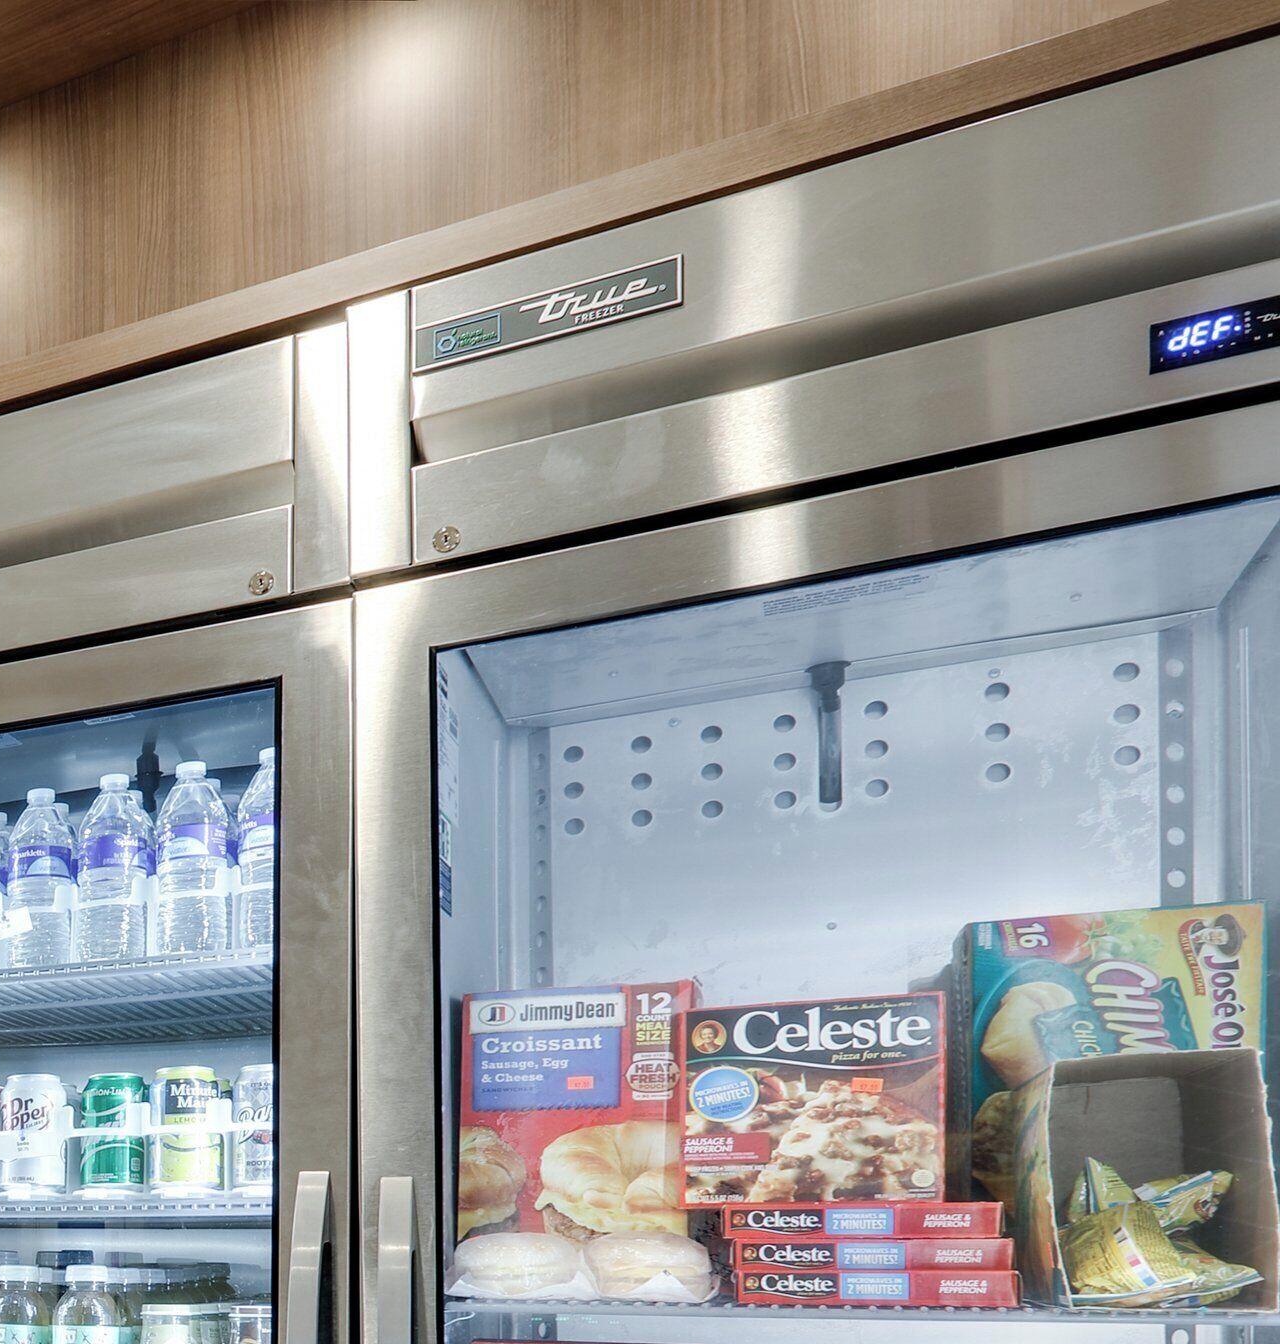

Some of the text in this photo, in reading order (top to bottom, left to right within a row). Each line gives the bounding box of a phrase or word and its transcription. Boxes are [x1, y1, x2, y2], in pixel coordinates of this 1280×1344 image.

[575, 304, 624, 324] FREEZER
[636, 992, 672, 1014] 12
[636, 1021, 671, 1031] MEAL
[733, 1006, 932, 1055] Celeste
[636, 1030, 671, 1042] SIZE
[481, 1033, 603, 1054] Croissant
[481, 1058, 570, 1070] Sausage, Egg
[635, 1063, 672, 1073] HEAT
[481, 1072, 544, 1083] & Cheese
[630, 1072, 676, 1084] FRESH
[170, 1084, 218, 1097] Minute
[12, 1098, 33, 1116] Dr
[684, 1145, 733, 1153] PEPPERONI
[747, 1211, 819, 1228] Celeste
[832, 1219, 886, 1230] 2 MINUTES!
[758, 1244, 832, 1262] Celeste
[760, 1274, 834, 1292] Celeste
